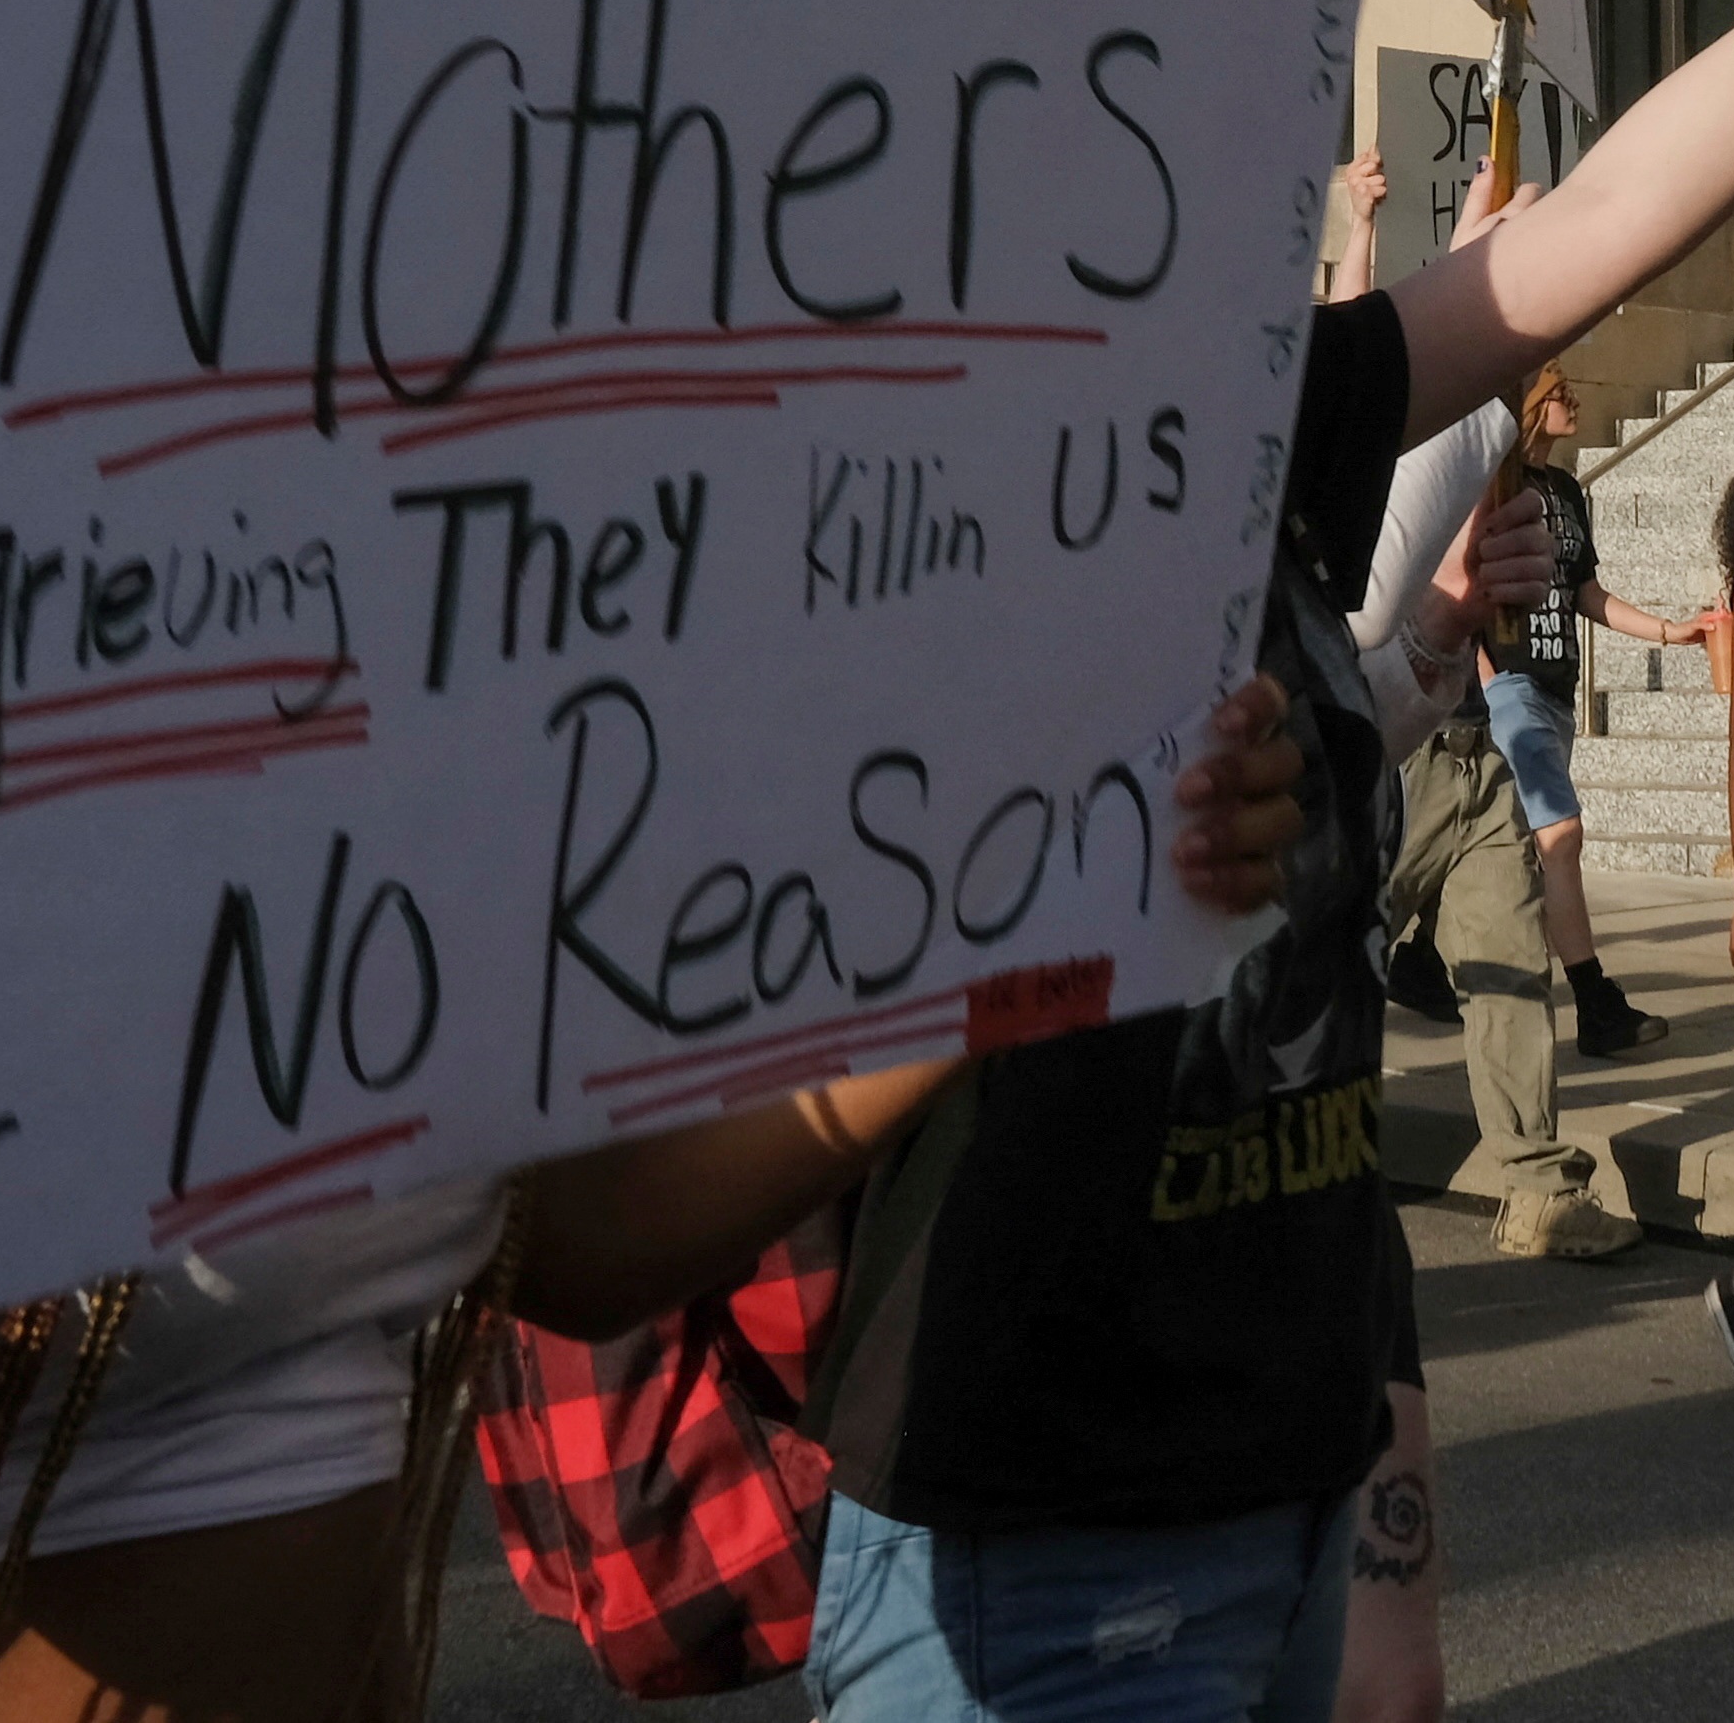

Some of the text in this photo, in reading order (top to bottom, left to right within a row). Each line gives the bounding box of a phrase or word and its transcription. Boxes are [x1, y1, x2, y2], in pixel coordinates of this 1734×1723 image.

[391, 470, 709, 692] They
[1529, 610, 1563, 638] PRO
[1530, 637, 1564, 661] PRO
